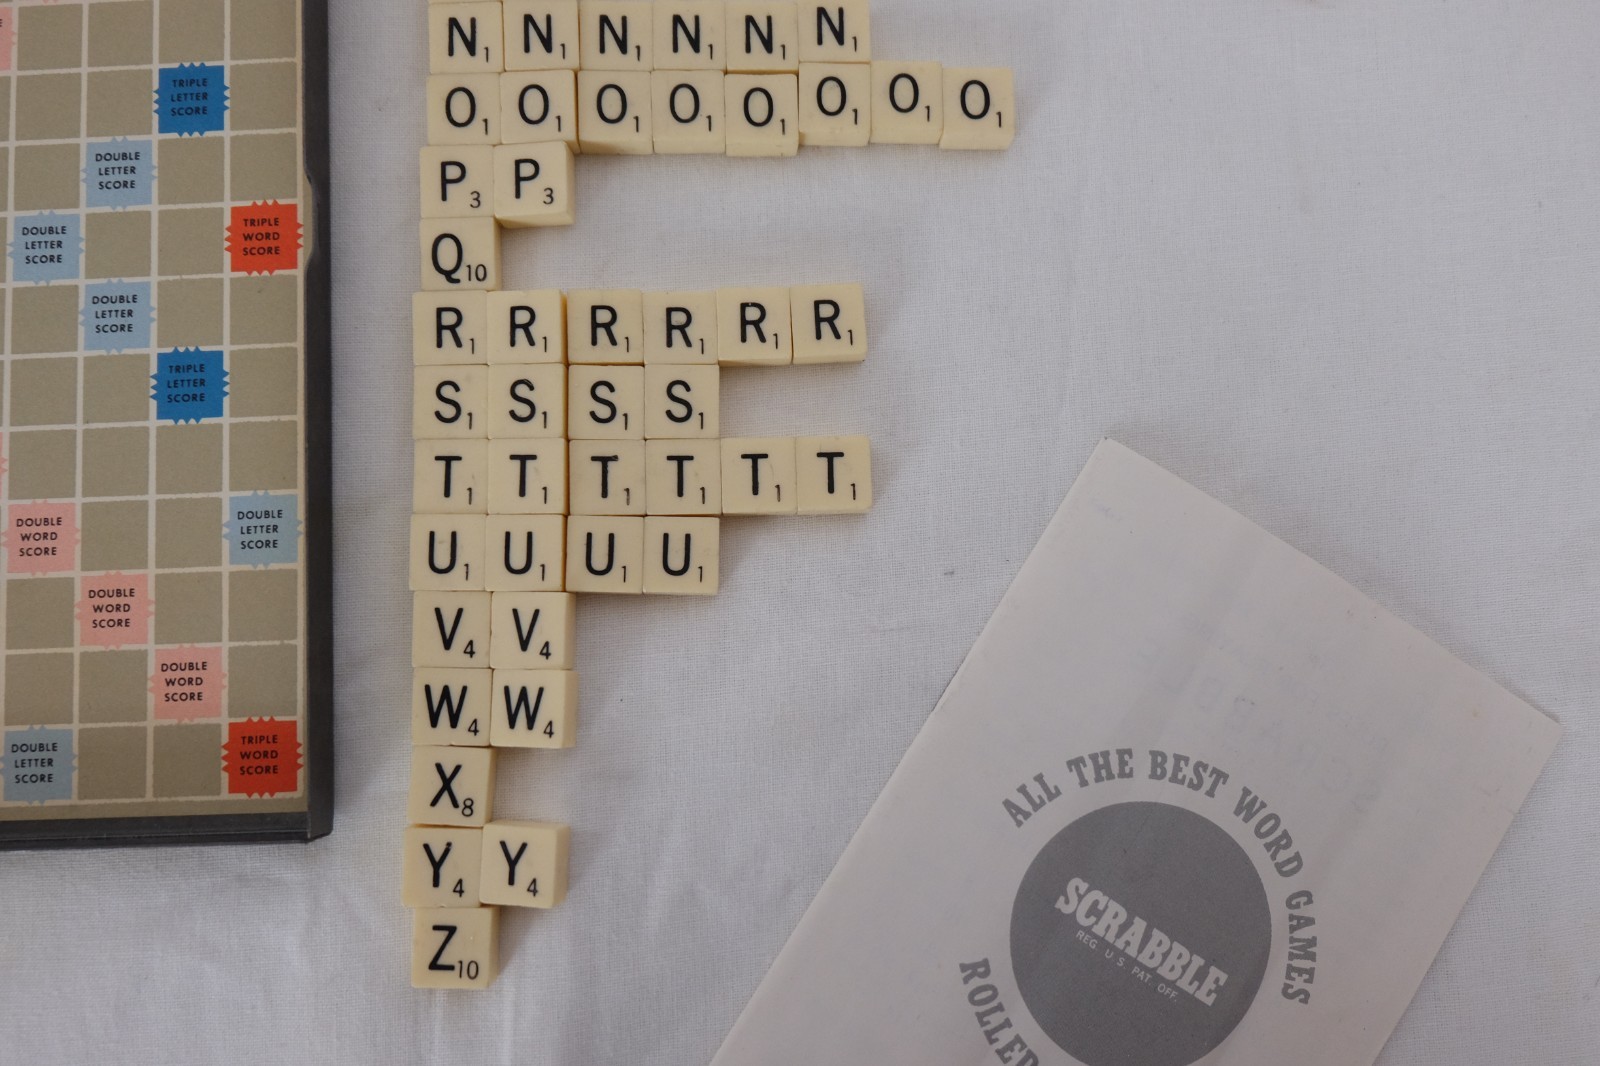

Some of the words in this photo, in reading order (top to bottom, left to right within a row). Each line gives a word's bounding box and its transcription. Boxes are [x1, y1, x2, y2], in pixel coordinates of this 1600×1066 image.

[172, 77, 208, 88] TRIPLE
[170, 91, 209, 103] LETTER
[170, 105, 208, 117] SCORE
[95, 151, 140, 162] DOUBLE
[98, 165, 137, 176] LETTER
[98, 179, 136, 190] SCORE
[243, 217, 280, 227] TRIPLE
[21, 225, 67, 236] DOUBLE
[242, 231, 280, 242] WORD
[25, 240, 63, 250] LETTER
[242, 245, 280, 257] SCORE
[25, 254, 63, 265] SCORE
[91, 294, 138, 305] DOUBLE
[95, 308, 134, 319] LETTER
[95, 323, 133, 334] SCORE
[168, 363, 205, 374] TRIPLE
[167, 378, 206, 389] LETTER
[167, 392, 205, 403] SCORE
[237, 509, 283, 520] DOUBLE
[16, 516, 62, 528] DOUBLE
[240, 524, 279, 535] LETTER
[20, 531, 58, 542] WORD
[240, 539, 278, 550] SCORE
[19, 546, 57, 557] SCORE
[88, 587, 135, 599] DOUBLE
[92, 603, 131, 613] WORD
[92, 618, 131, 629] SCORE
[160, 661, 208, 673] DOUBLE
[164, 676, 204, 687] WORD
[164, 691, 203, 703] SCORE
[241, 734, 278, 745] TRIPLE
[11, 742, 58, 754] DOUBLE
[239, 749, 279, 760] WORD
[14, 757, 54, 769] LETTER
[239, 764, 279, 776] SCORE
[14, 773, 54, 784] SCORE
[1002, 773, 1062, 828] ALL
[1066, 748, 1134, 788] THE
[1148, 750, 1230, 799] BEST
[1233, 786, 1304, 878] WORD
[1280, 889, 1318, 1006] GAMES
[1054, 876, 1229, 1006] SCRABBLE
